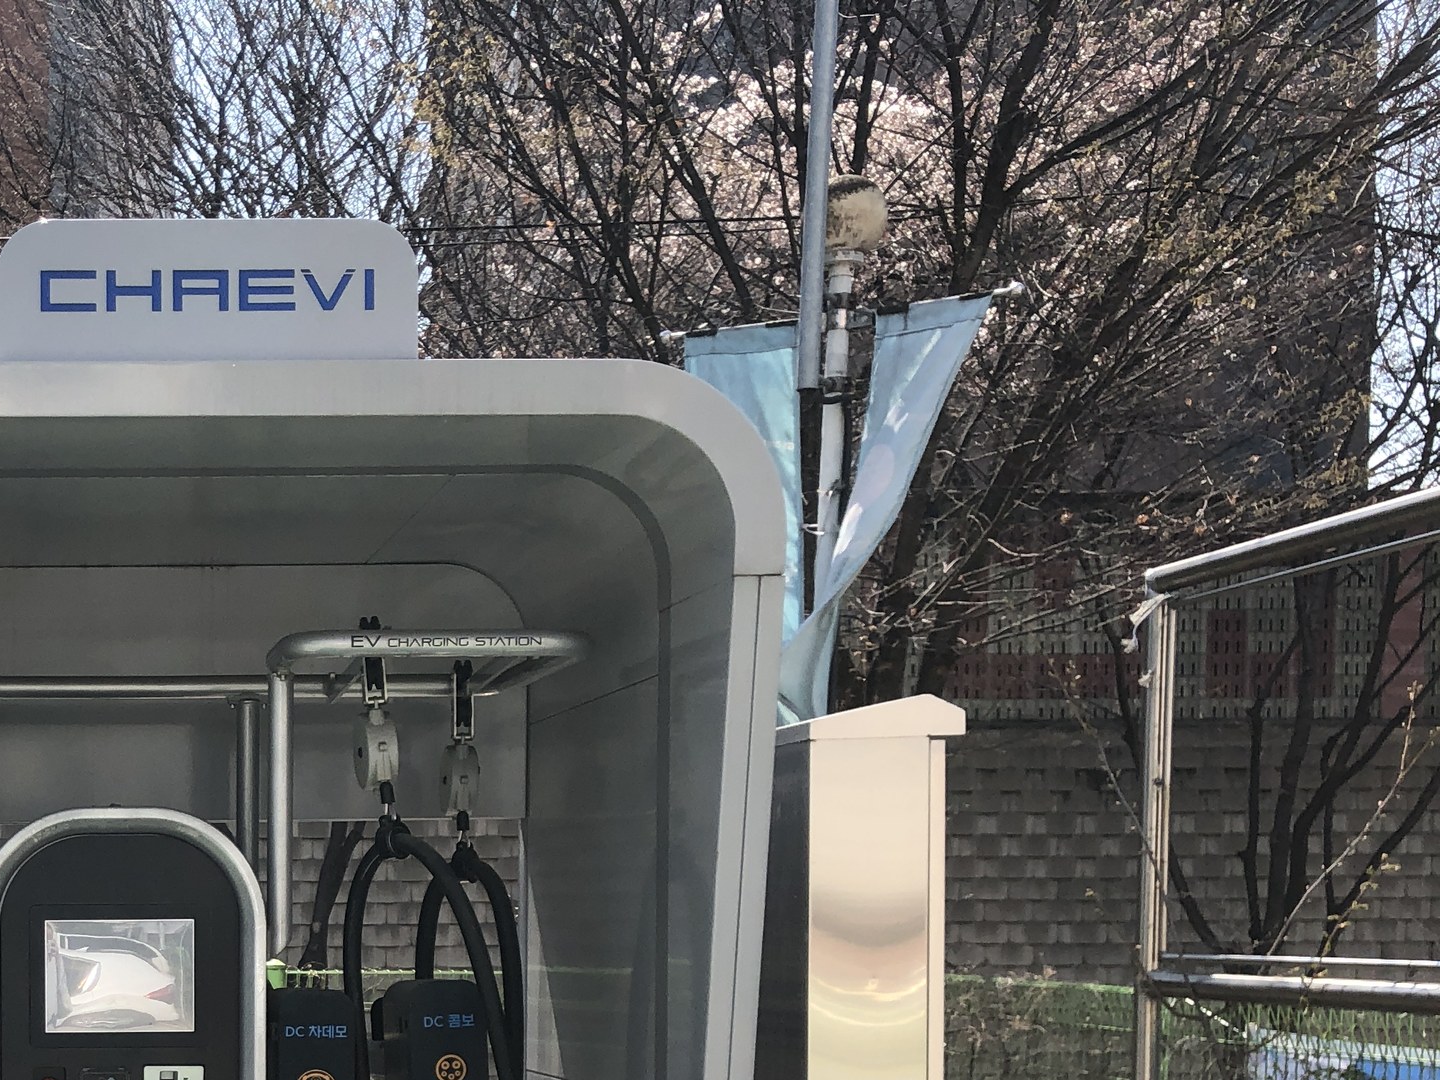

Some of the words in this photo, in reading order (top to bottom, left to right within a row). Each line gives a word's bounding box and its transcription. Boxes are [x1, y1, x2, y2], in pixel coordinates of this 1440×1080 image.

[40, 268, 375, 312] CHAEVI
[350, 635, 382, 648] EV
[388, 636, 469, 648] CHARGING
[475, 636, 543, 647] STATION
[423, 1015, 444, 1028] DC
[448, 1013, 475, 1028] 콤보
[284, 1026, 305, 1038] DC
[309, 1024, 348, 1039] 차데모
